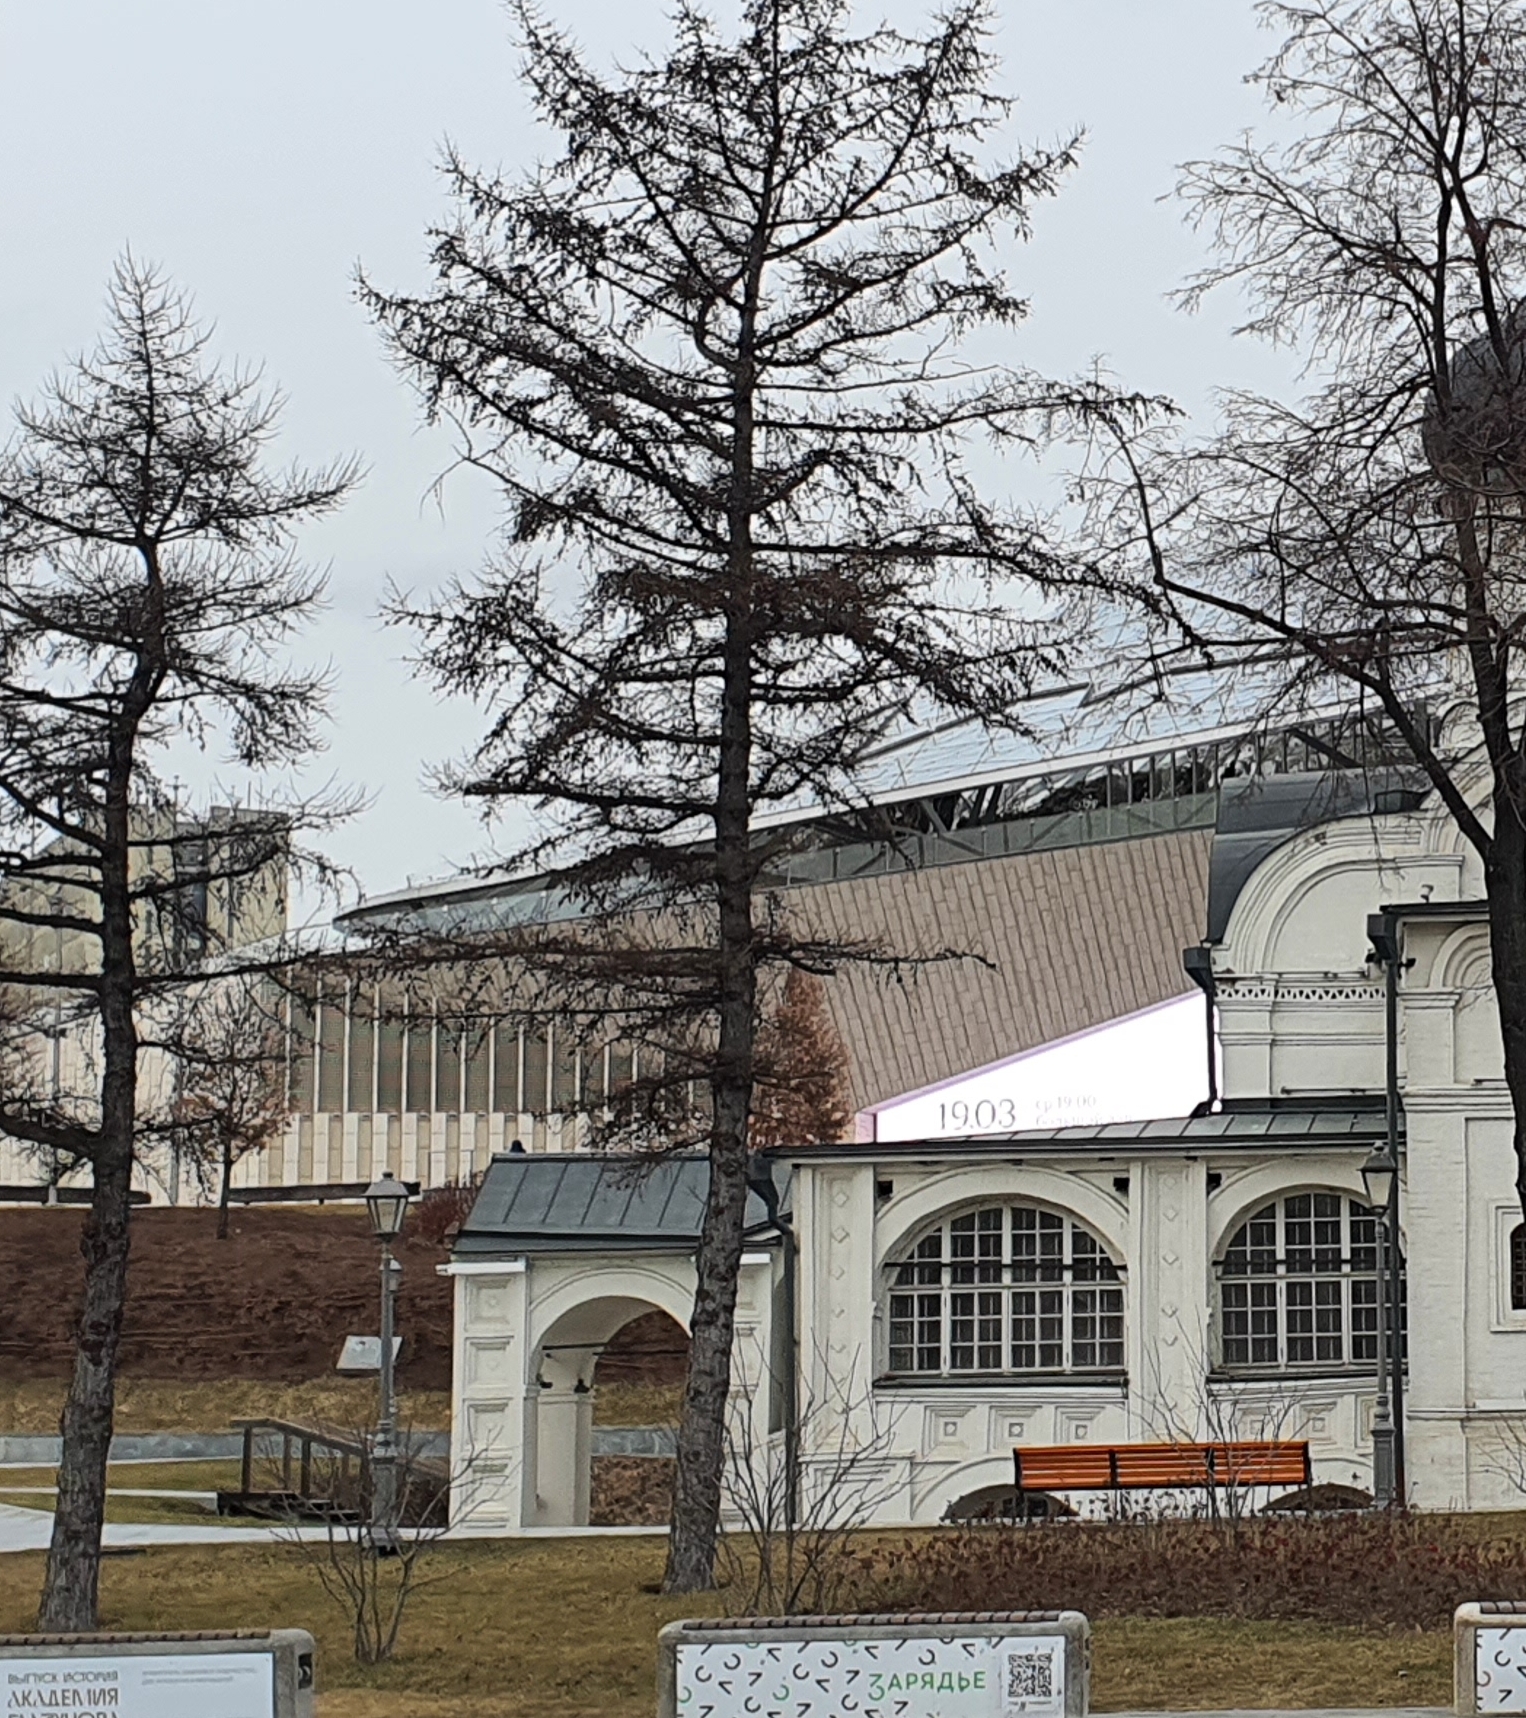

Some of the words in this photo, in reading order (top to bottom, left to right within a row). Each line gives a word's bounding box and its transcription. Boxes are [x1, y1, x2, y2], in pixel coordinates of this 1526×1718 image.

[939, 1098, 1016, 1131] 19.03
[1057, 1095, 1097, 1109] 1900
[7, 1687, 119, 1708] АКАДЕМИЯ
[868, 1670, 987, 1701] ЗАРЯДЬЕ
